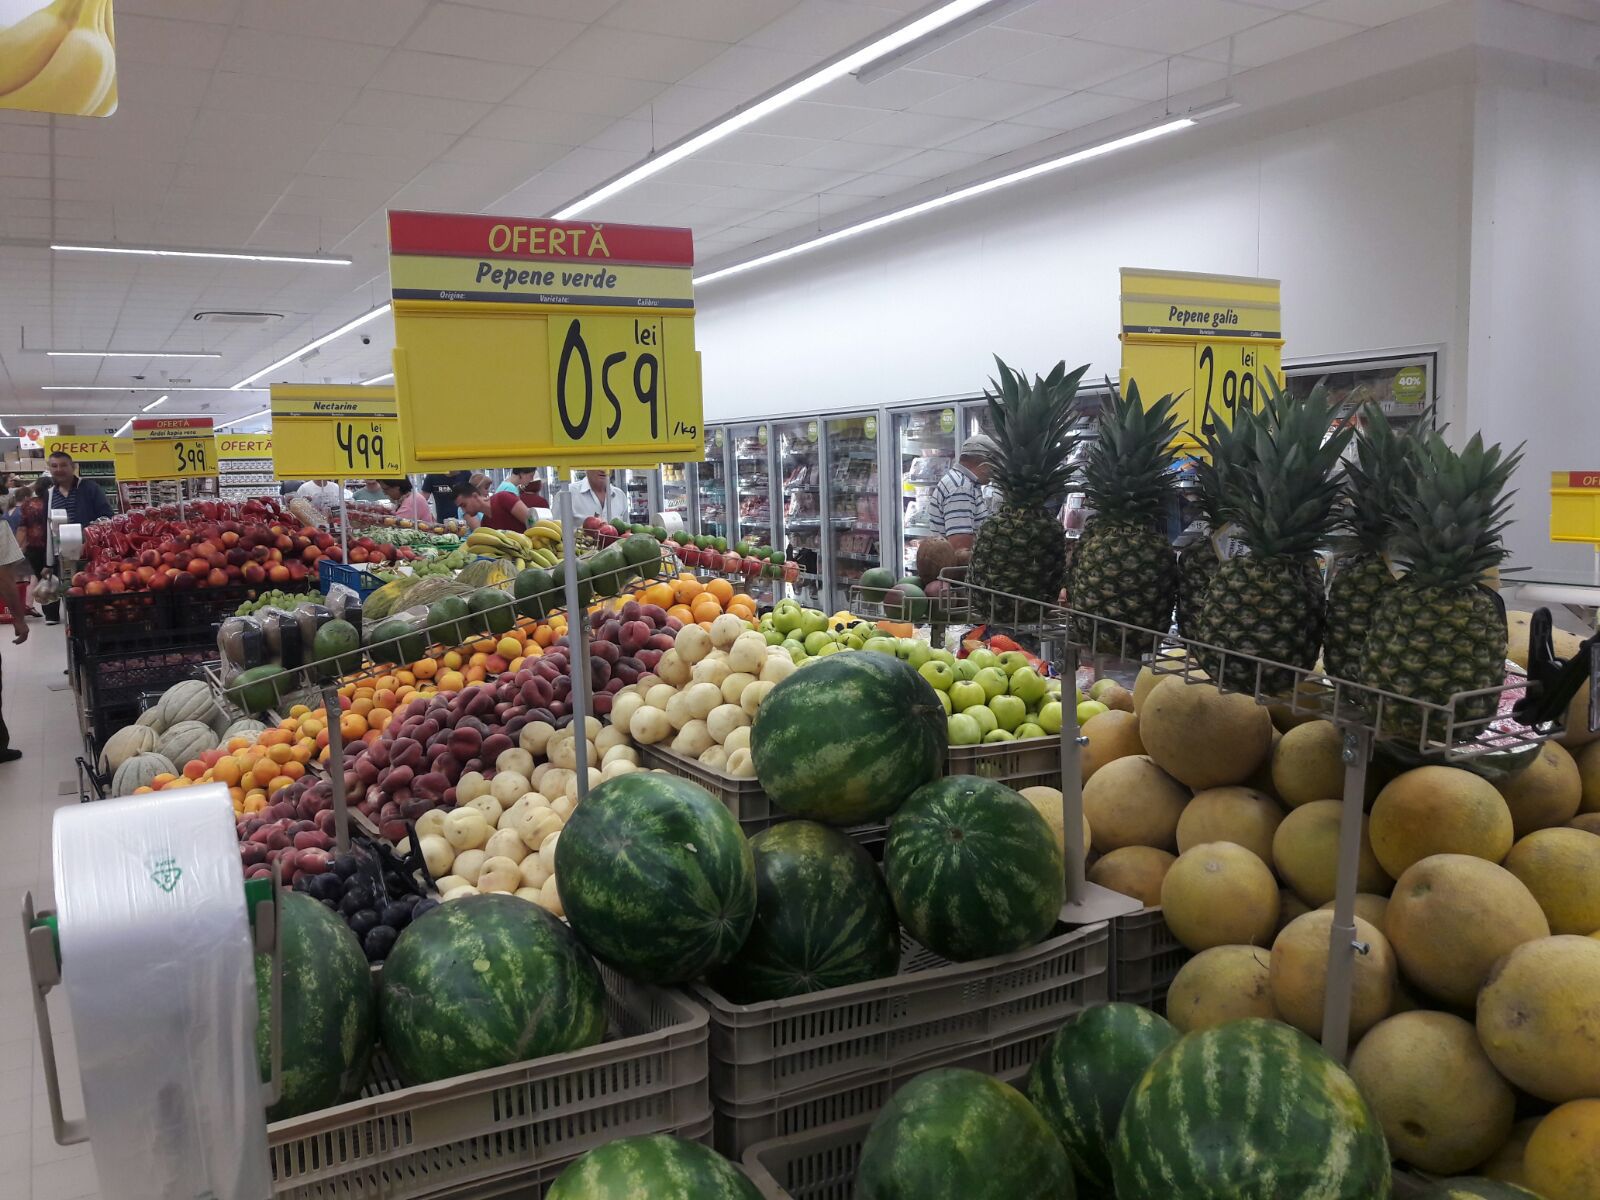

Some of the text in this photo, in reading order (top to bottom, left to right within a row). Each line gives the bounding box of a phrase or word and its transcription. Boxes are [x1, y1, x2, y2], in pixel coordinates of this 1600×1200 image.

[488, 223, 610, 258] OFERTĂ
[475, 262, 617, 290] Pepene verde
[1168, 305, 1238, 328] Pepene galia
[635, 318, 657, 346] lei
[1241, 346, 1254, 367] lei
[1398, 376, 1421, 386] 40%
[313, 401, 358, 411] Nectarine
[370, 421, 382, 433] lei
[673, 421, 697, 440] /kg
[50, 440, 111, 453] OFERTĂ
[336, 421, 384, 470] 499
[174, 441, 206, 472] 399
[1583, 476, 1600, 486] OF
